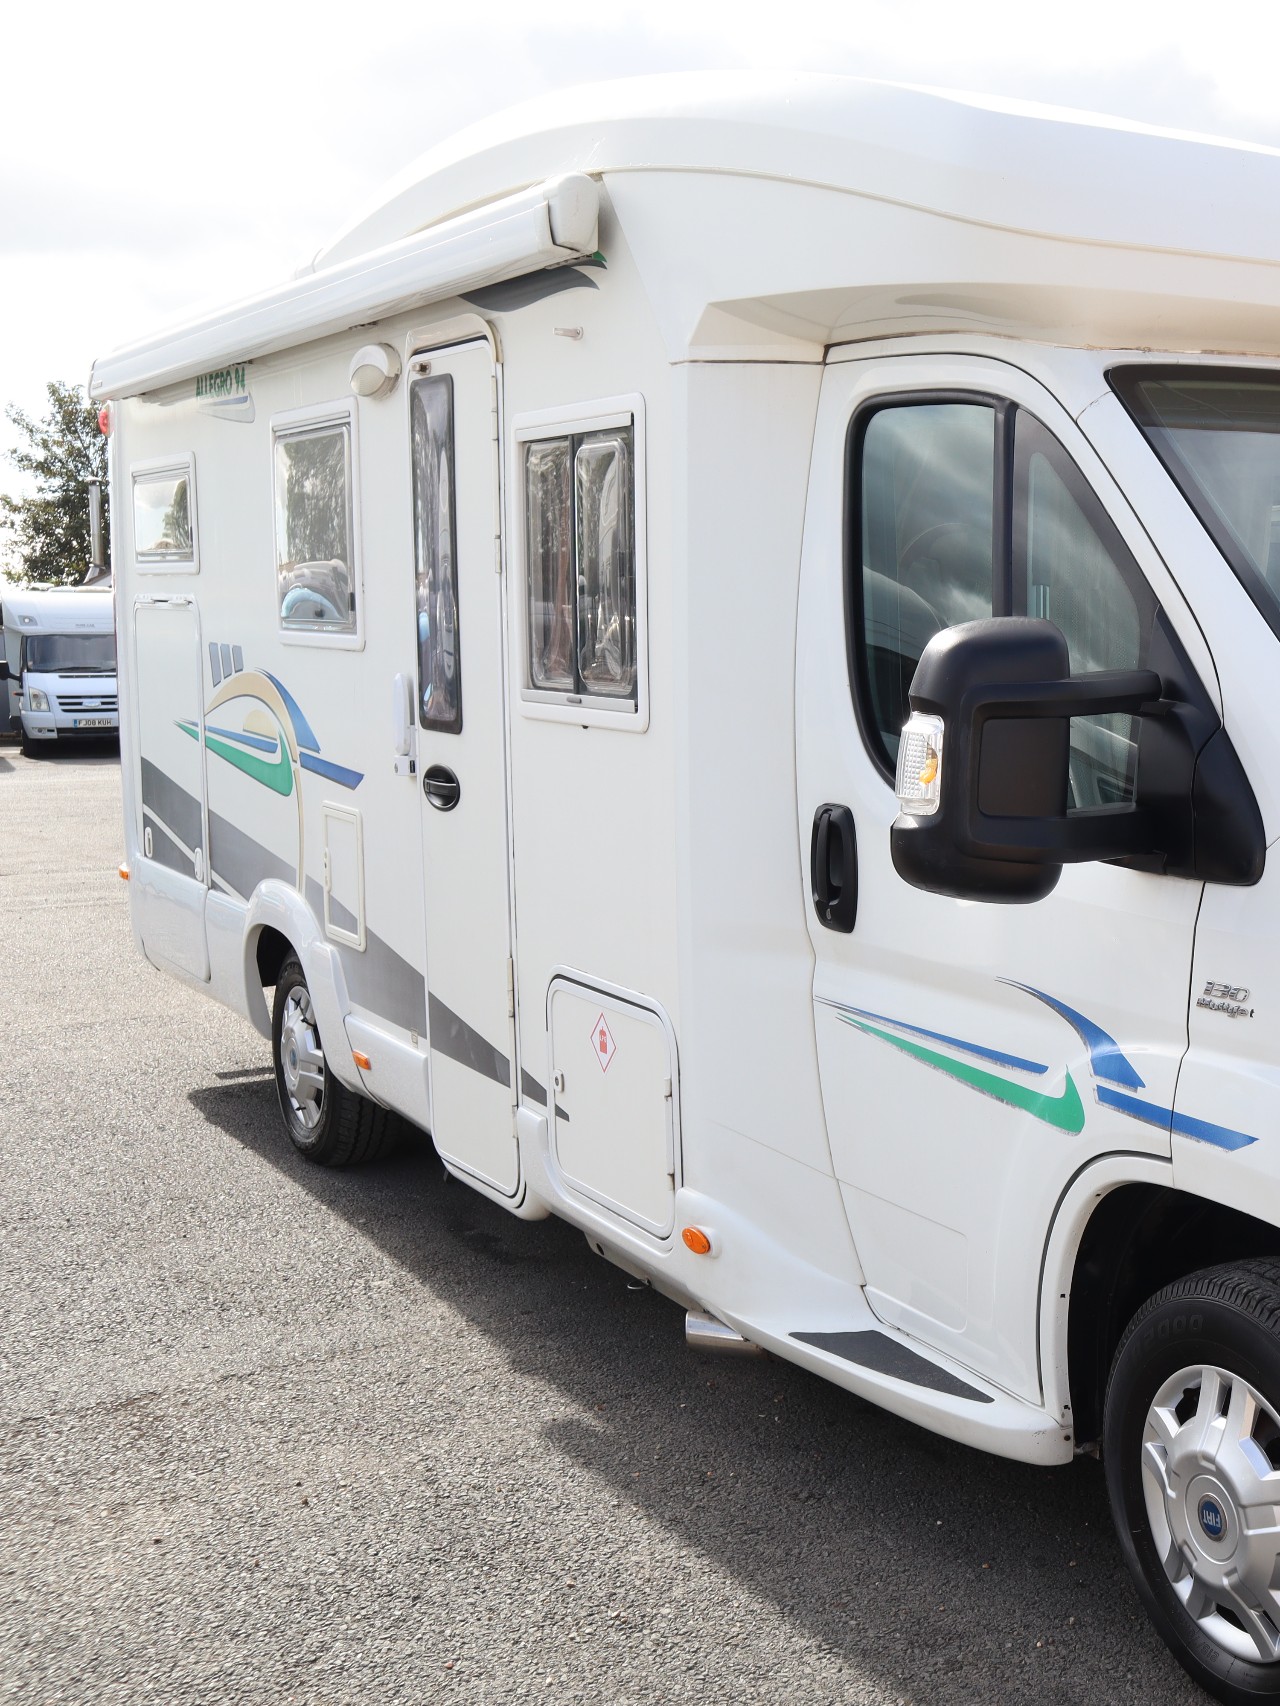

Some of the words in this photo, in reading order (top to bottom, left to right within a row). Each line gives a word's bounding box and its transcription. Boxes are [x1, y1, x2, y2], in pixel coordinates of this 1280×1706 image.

[235, 366, 246, 394] 94
[1203, 981, 1250, 1002] 130
[1202, 1509, 1221, 1528] FIAT
